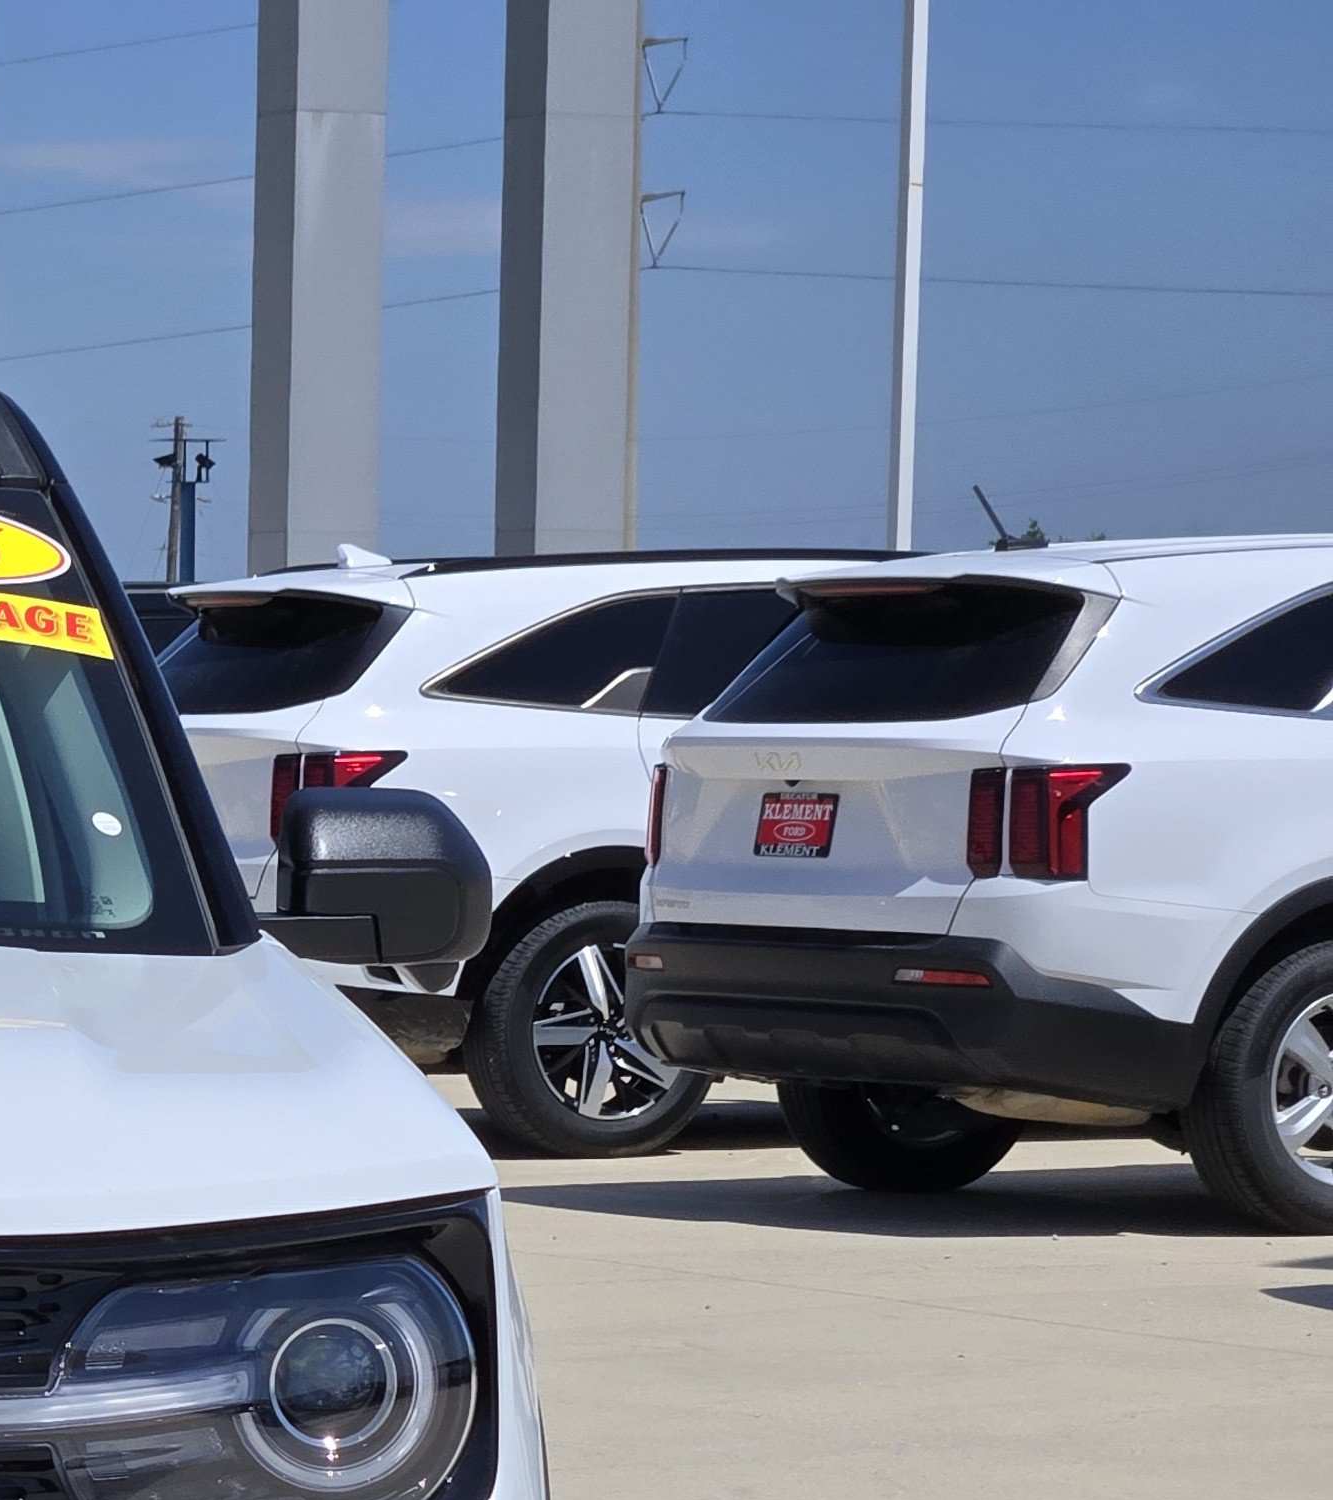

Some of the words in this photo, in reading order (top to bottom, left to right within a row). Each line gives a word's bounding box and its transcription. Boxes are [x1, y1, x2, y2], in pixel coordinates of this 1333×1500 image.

[762, 803, 834, 821] KLEMENT
[783, 826, 807, 837] FORD
[760, 844, 821, 857] KLEMENT
